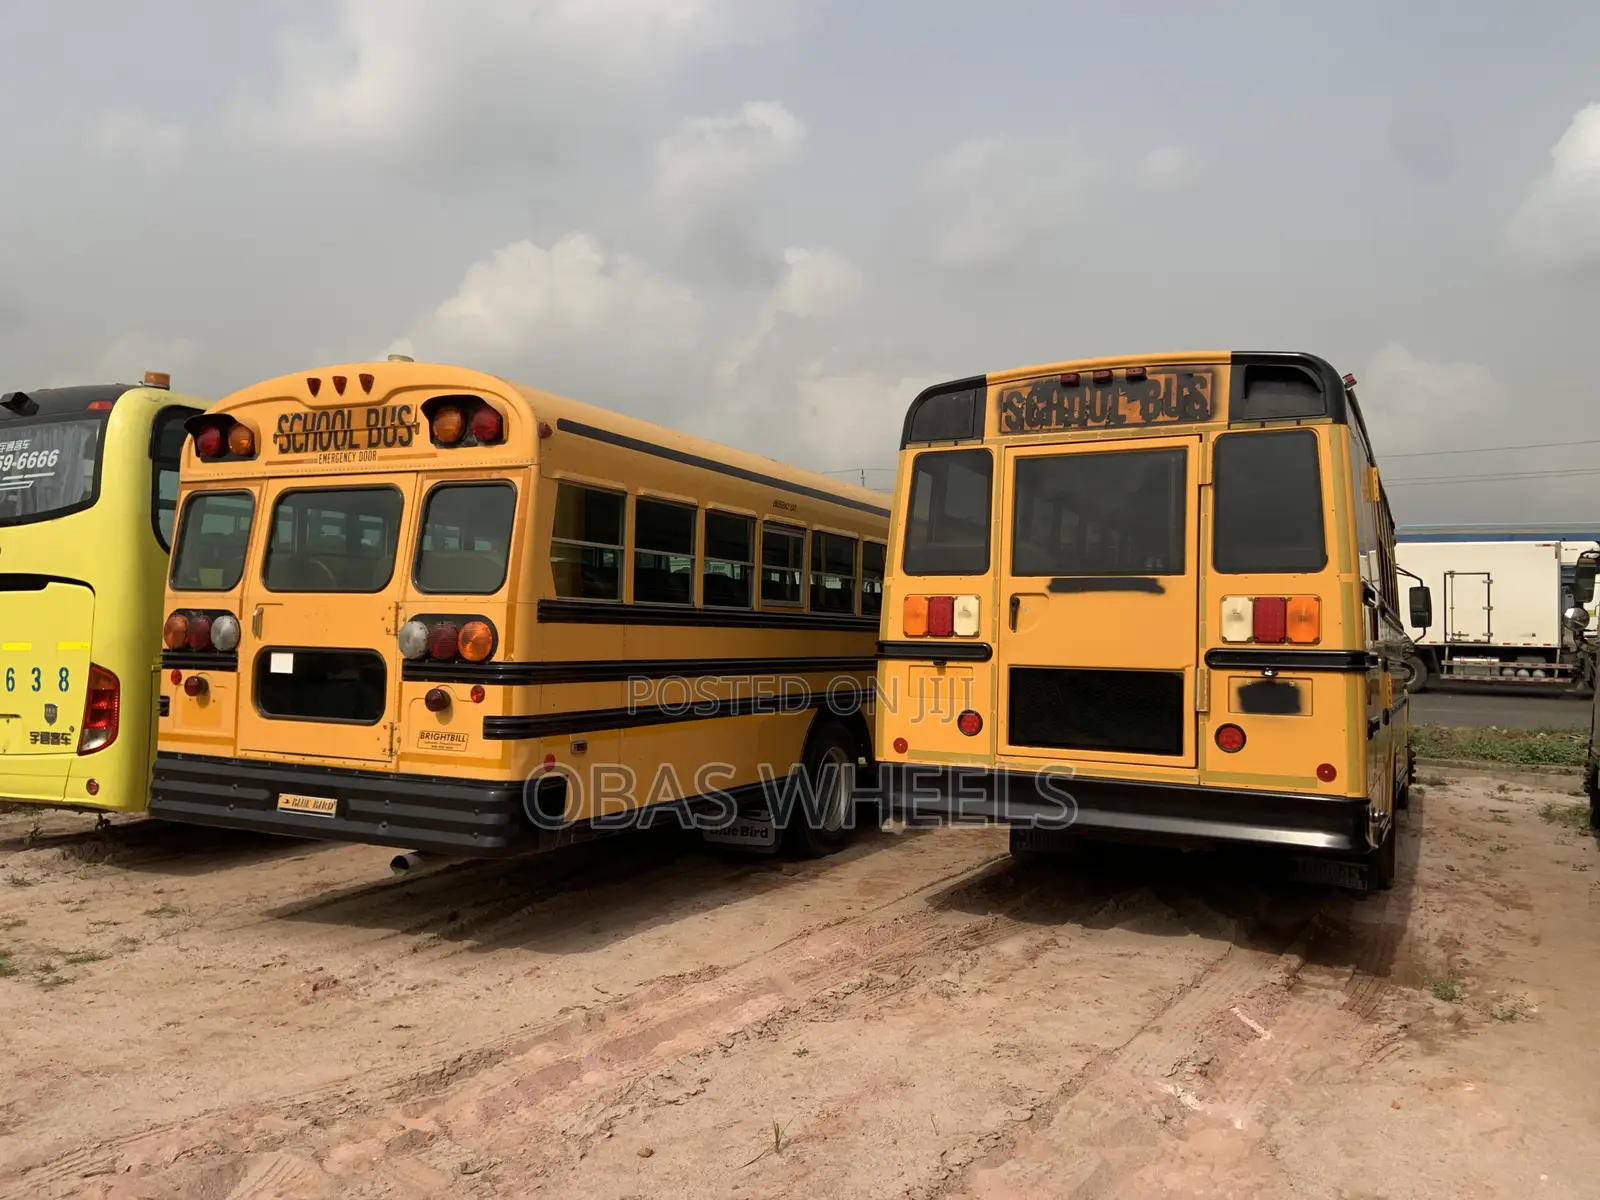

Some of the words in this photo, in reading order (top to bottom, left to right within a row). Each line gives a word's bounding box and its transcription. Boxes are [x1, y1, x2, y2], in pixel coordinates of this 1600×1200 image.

[278, 409, 360, 454] SCHOOL
[366, 404, 413, 448] BUS
[318, 451, 356, 464] EMERGENCY
[358, 450, 377, 462] DOOR
[420, 732, 466, 743] BRIGHTBILL
[739, 825, 769, 839] Bird
